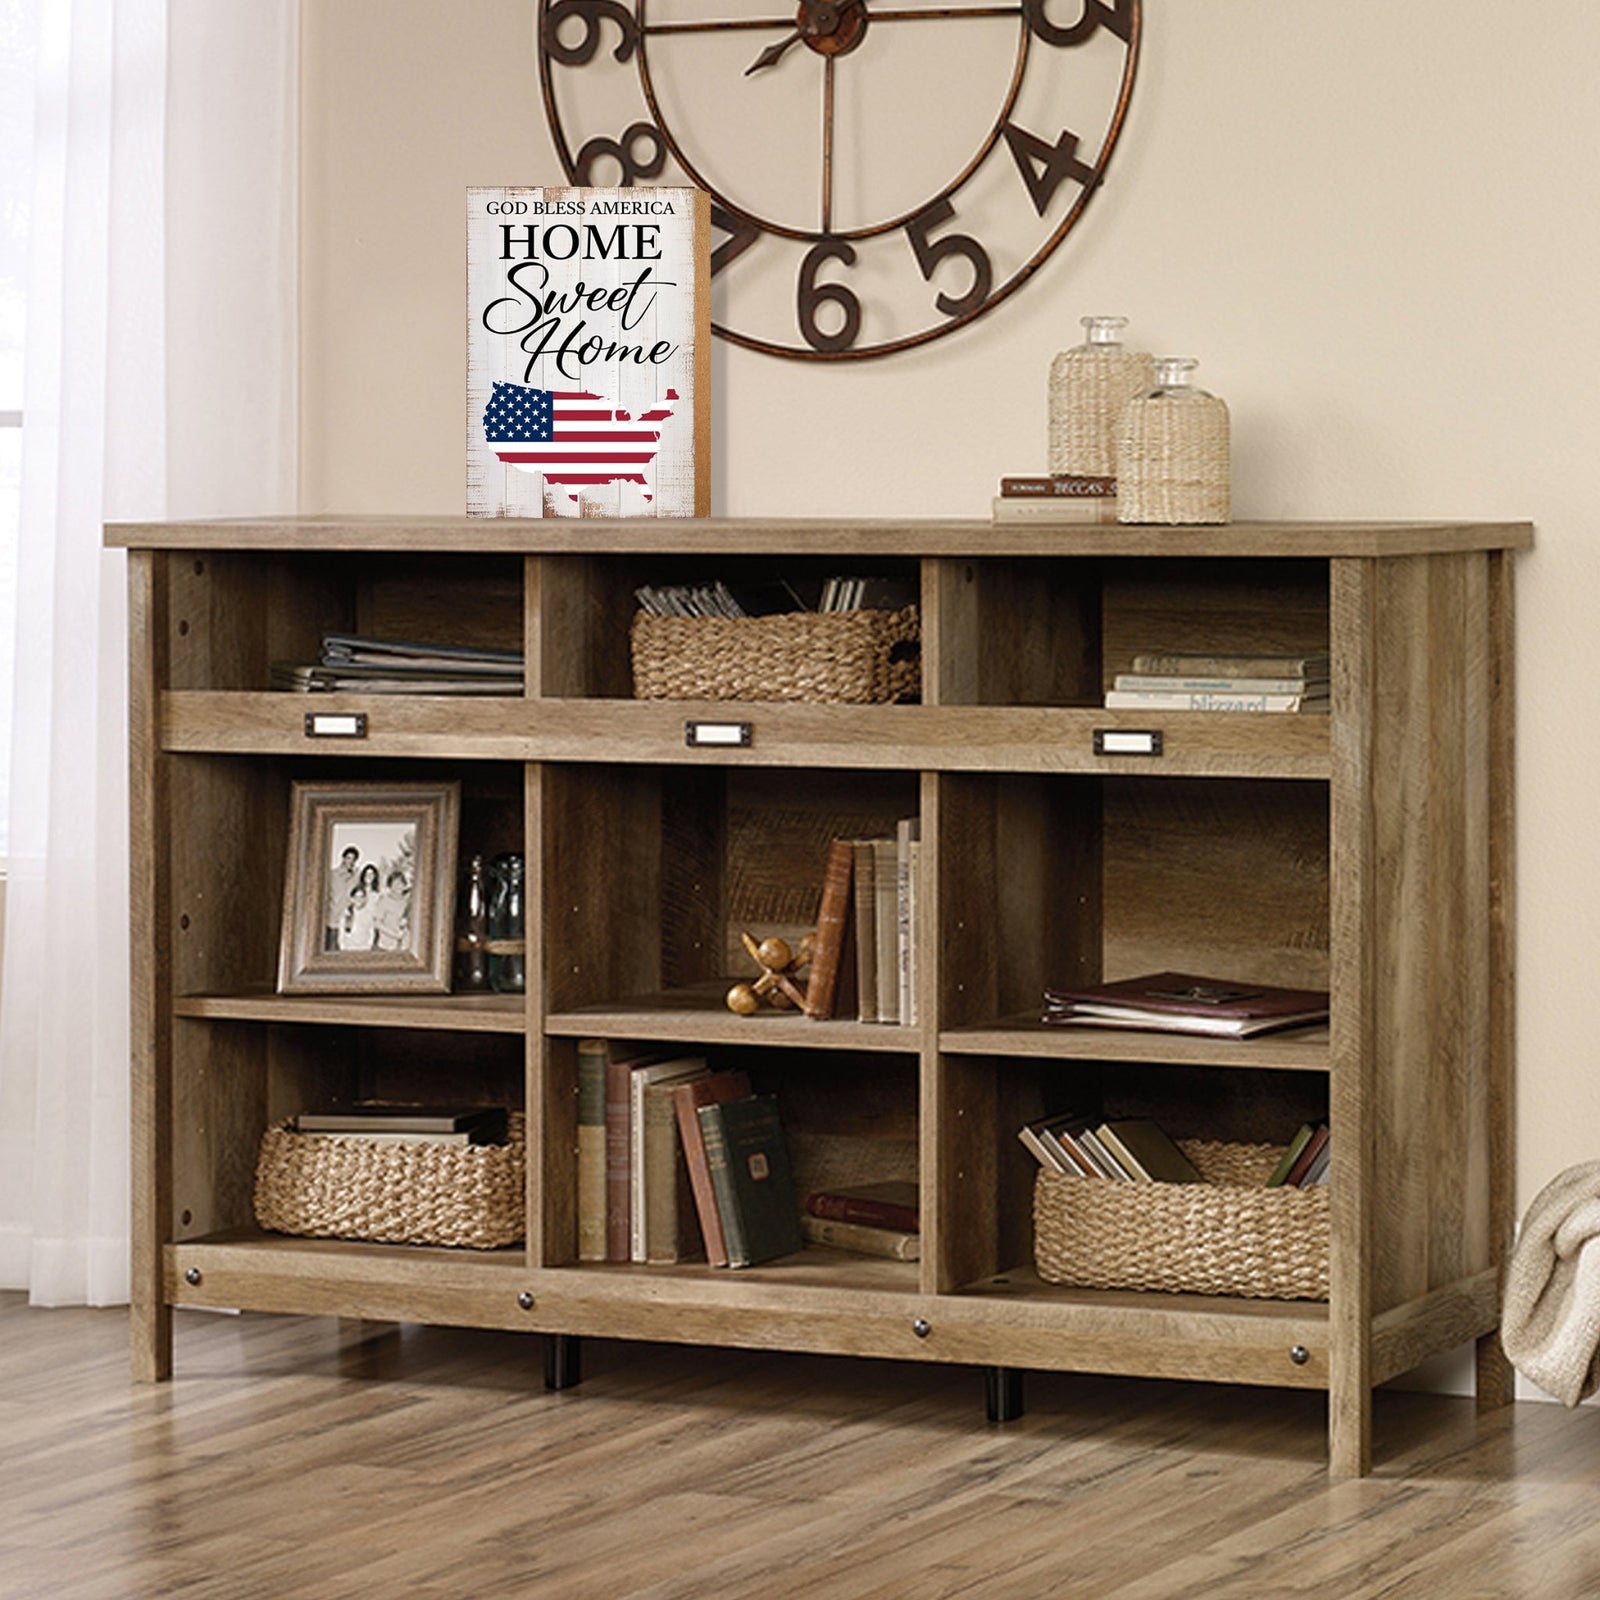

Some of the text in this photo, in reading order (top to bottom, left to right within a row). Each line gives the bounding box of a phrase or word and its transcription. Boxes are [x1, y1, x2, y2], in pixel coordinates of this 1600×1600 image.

[1001, 121, 1097, 218] 4
[486, 201, 675, 215] GOD BLESS AMERICA
[499, 224, 663, 260] HOME
[904, 199, 992, 318] 5
[483, 262, 677, 334] Sweet
[799, 240, 861, 352] 6
[520, 317, 679, 383] Home
